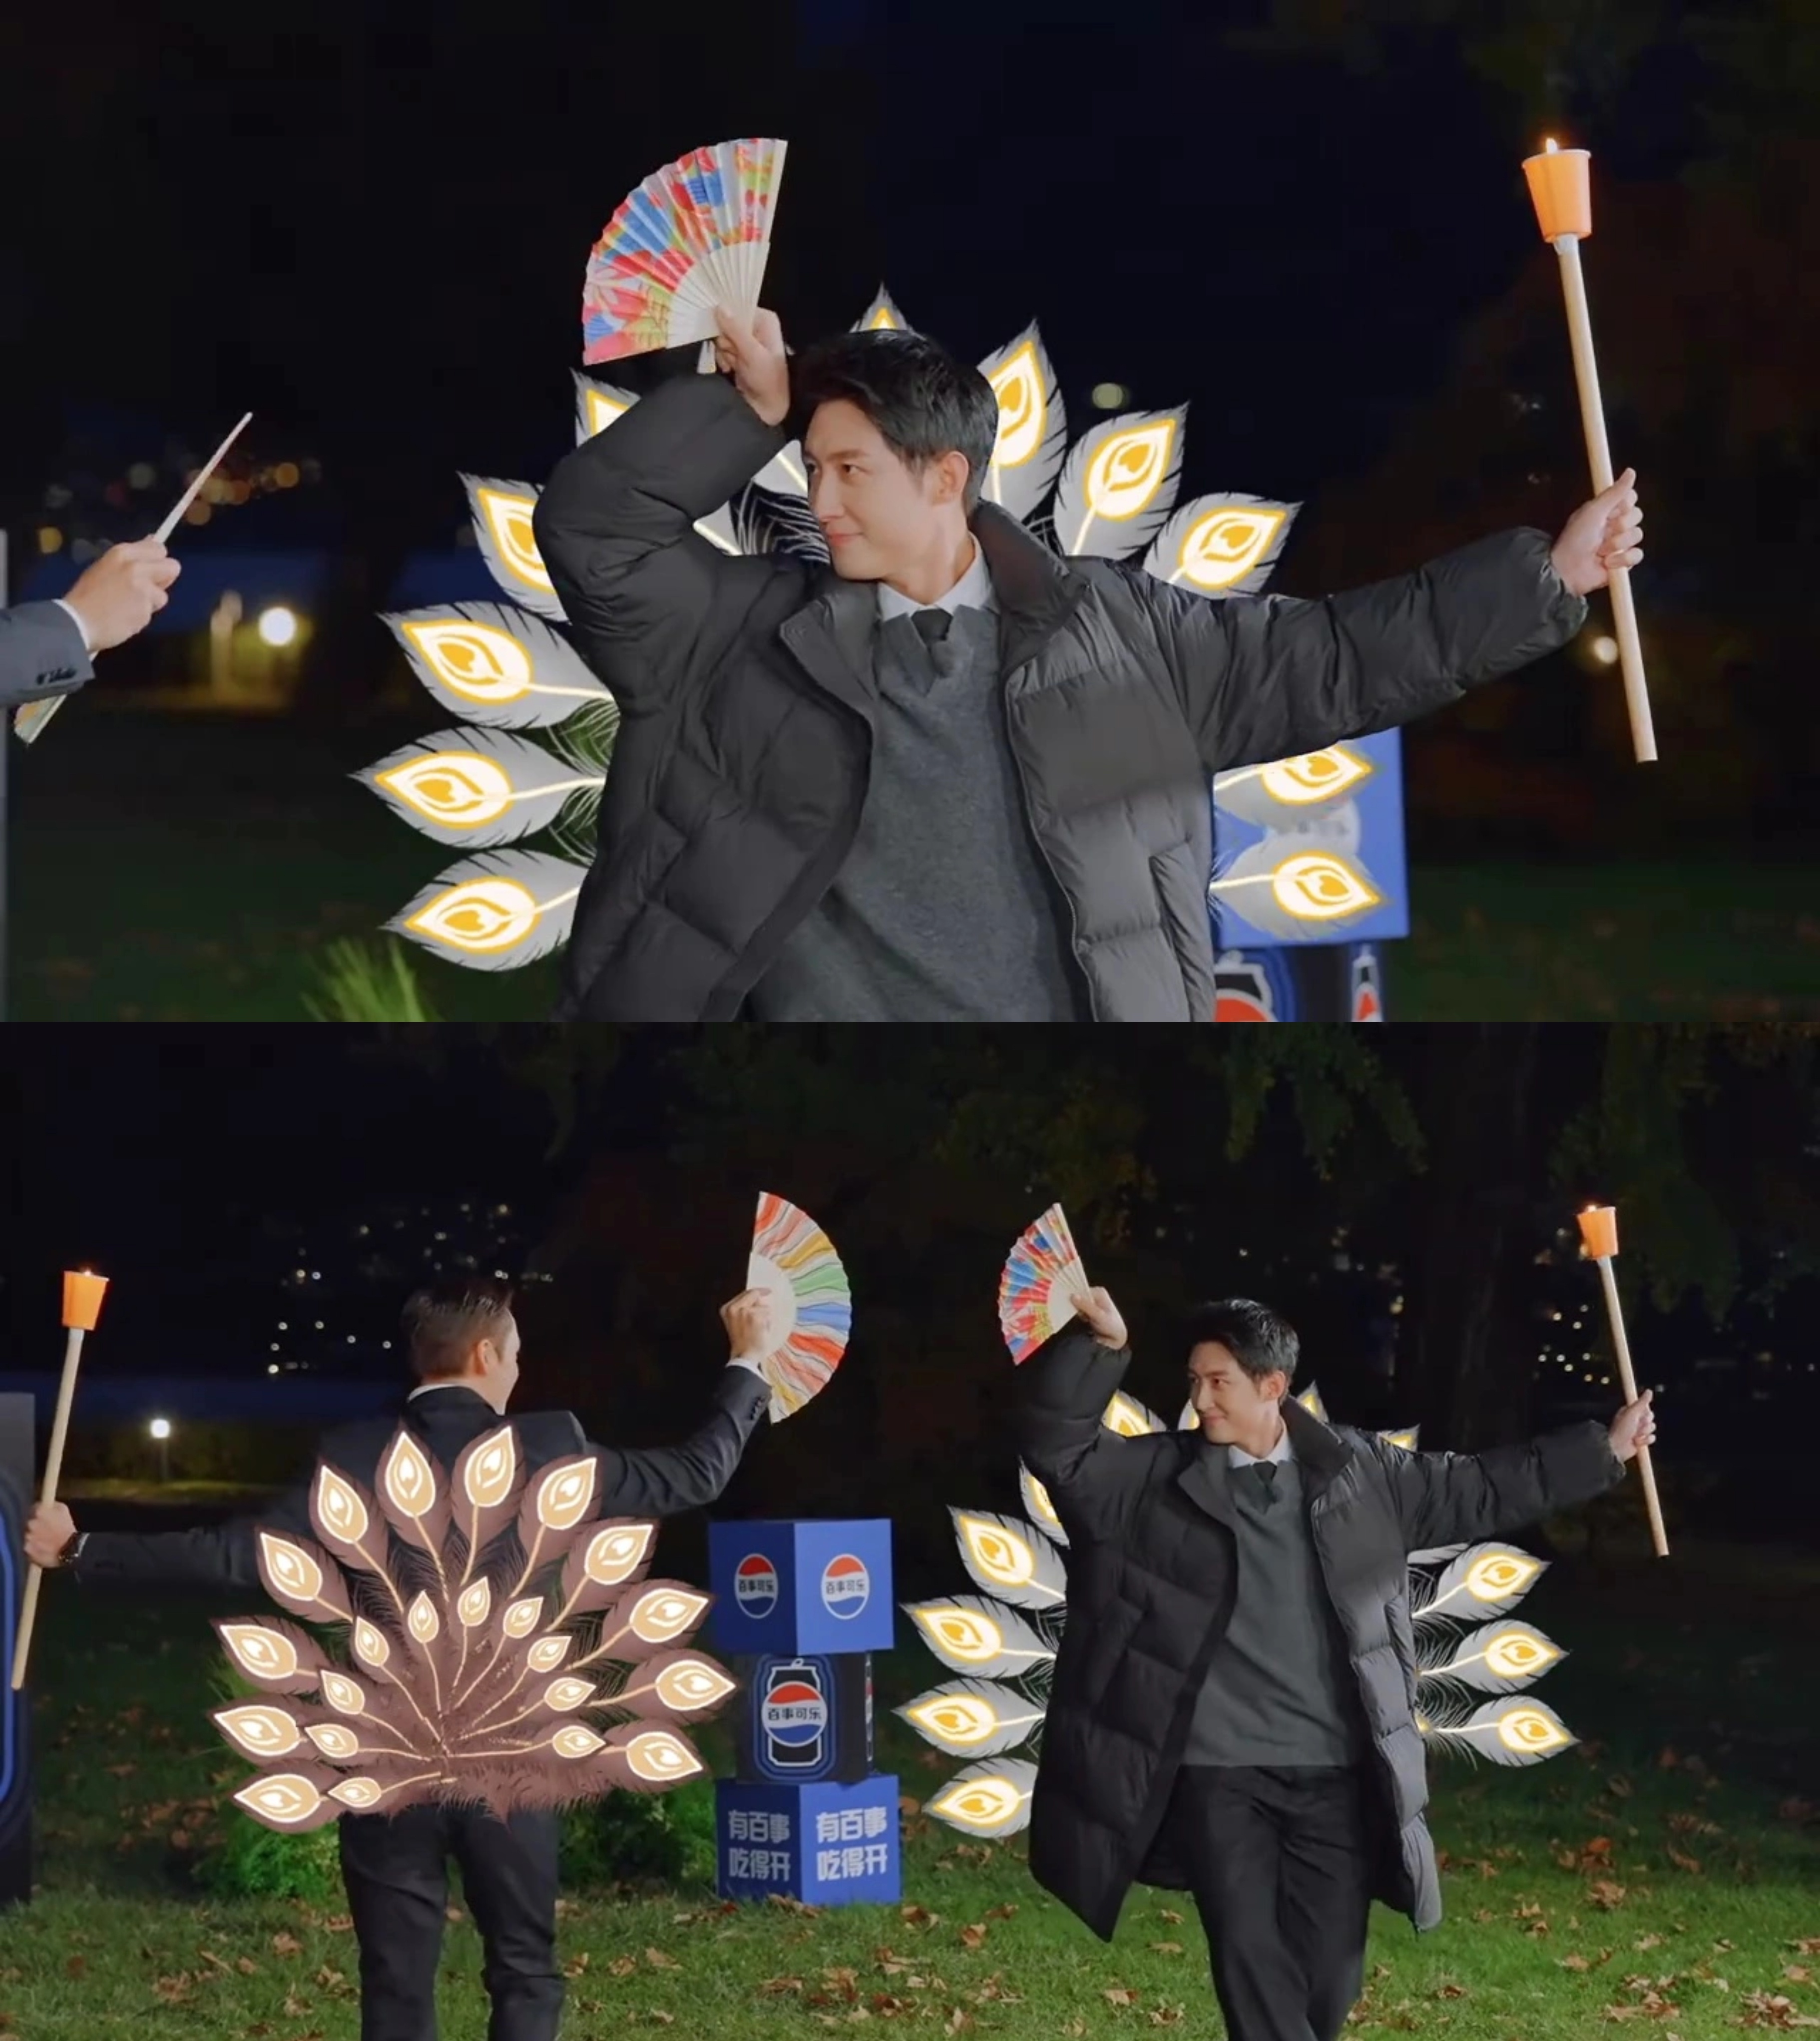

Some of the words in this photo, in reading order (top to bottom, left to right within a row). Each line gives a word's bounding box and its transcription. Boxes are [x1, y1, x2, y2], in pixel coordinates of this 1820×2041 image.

[738, 1579, 774, 1592] 百事可乐
[826, 1580, 866, 1594] 百事可乐
[768, 1707, 822, 1720] 百事可乐
[729, 1810, 790, 1843] 有百事
[816, 1807, 887, 1843] 有百事
[729, 1848, 790, 1881] 吃得开
[817, 1844, 887, 1881] 吃得开
